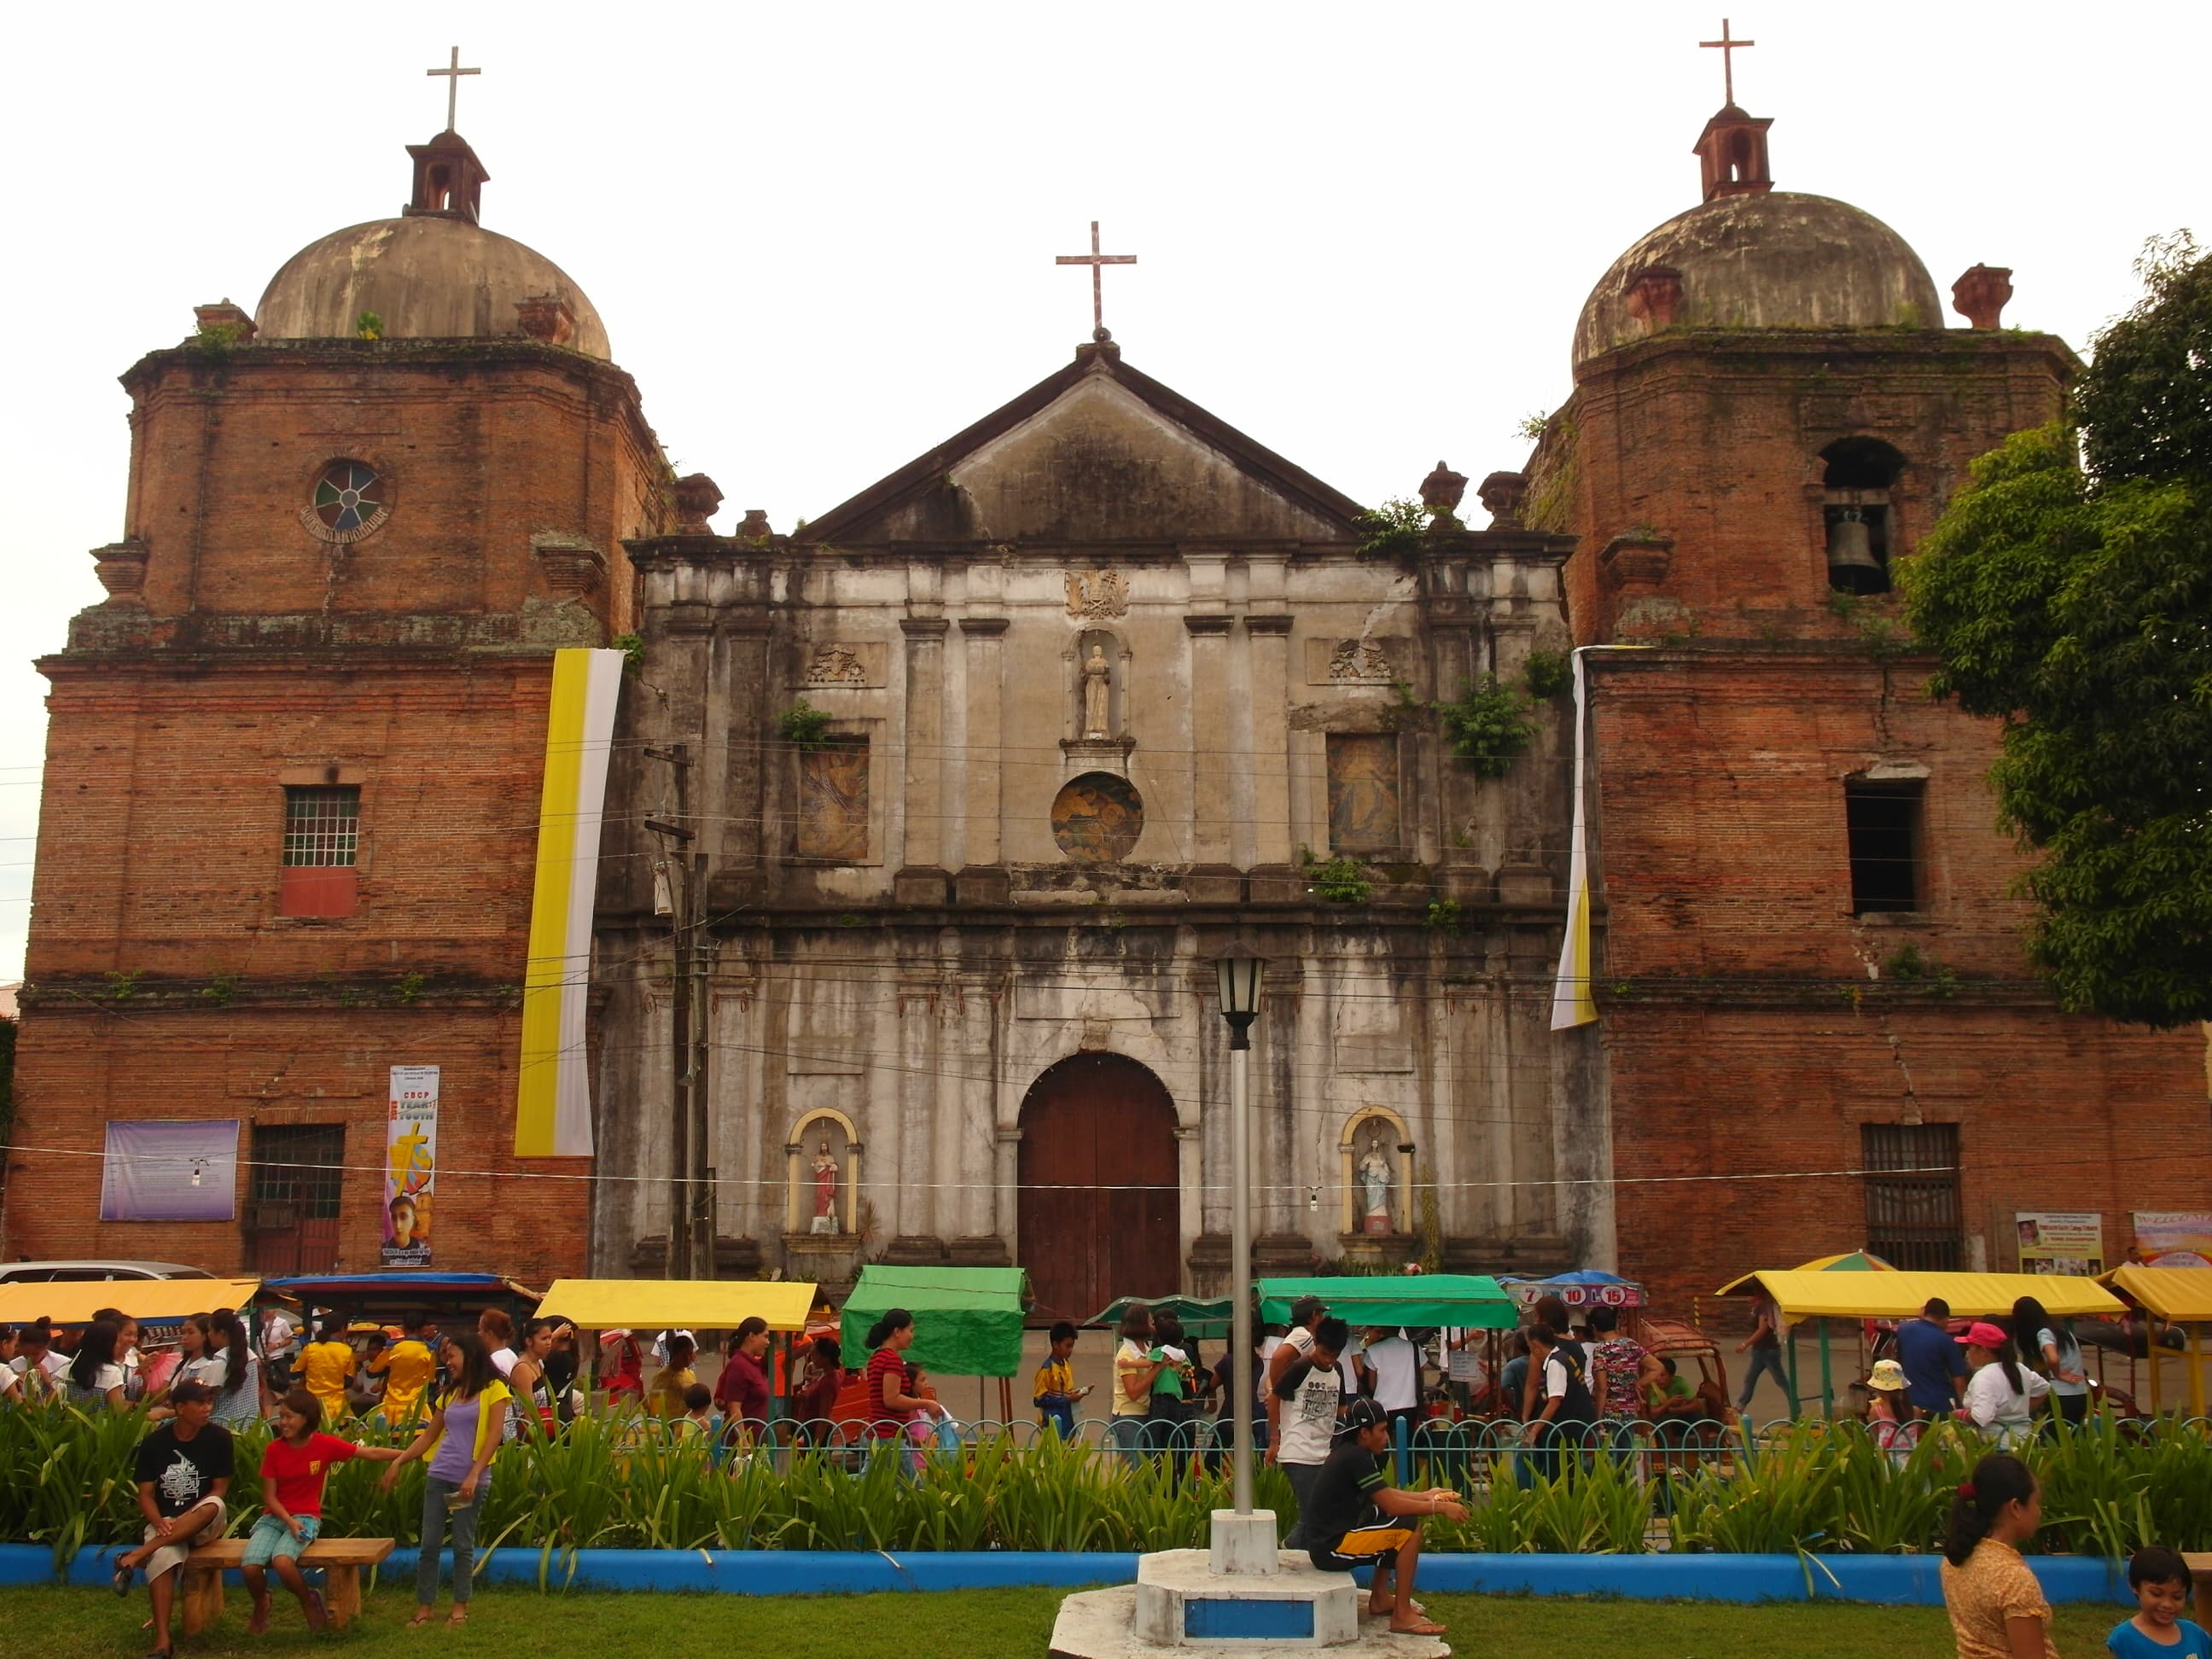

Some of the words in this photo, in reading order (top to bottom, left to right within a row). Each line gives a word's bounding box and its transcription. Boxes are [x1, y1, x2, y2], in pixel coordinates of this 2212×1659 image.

[1525, 1289, 1535, 1302] 7
[1565, 1289, 1581, 1302] 10
[1605, 1289, 1621, 1303] 15
